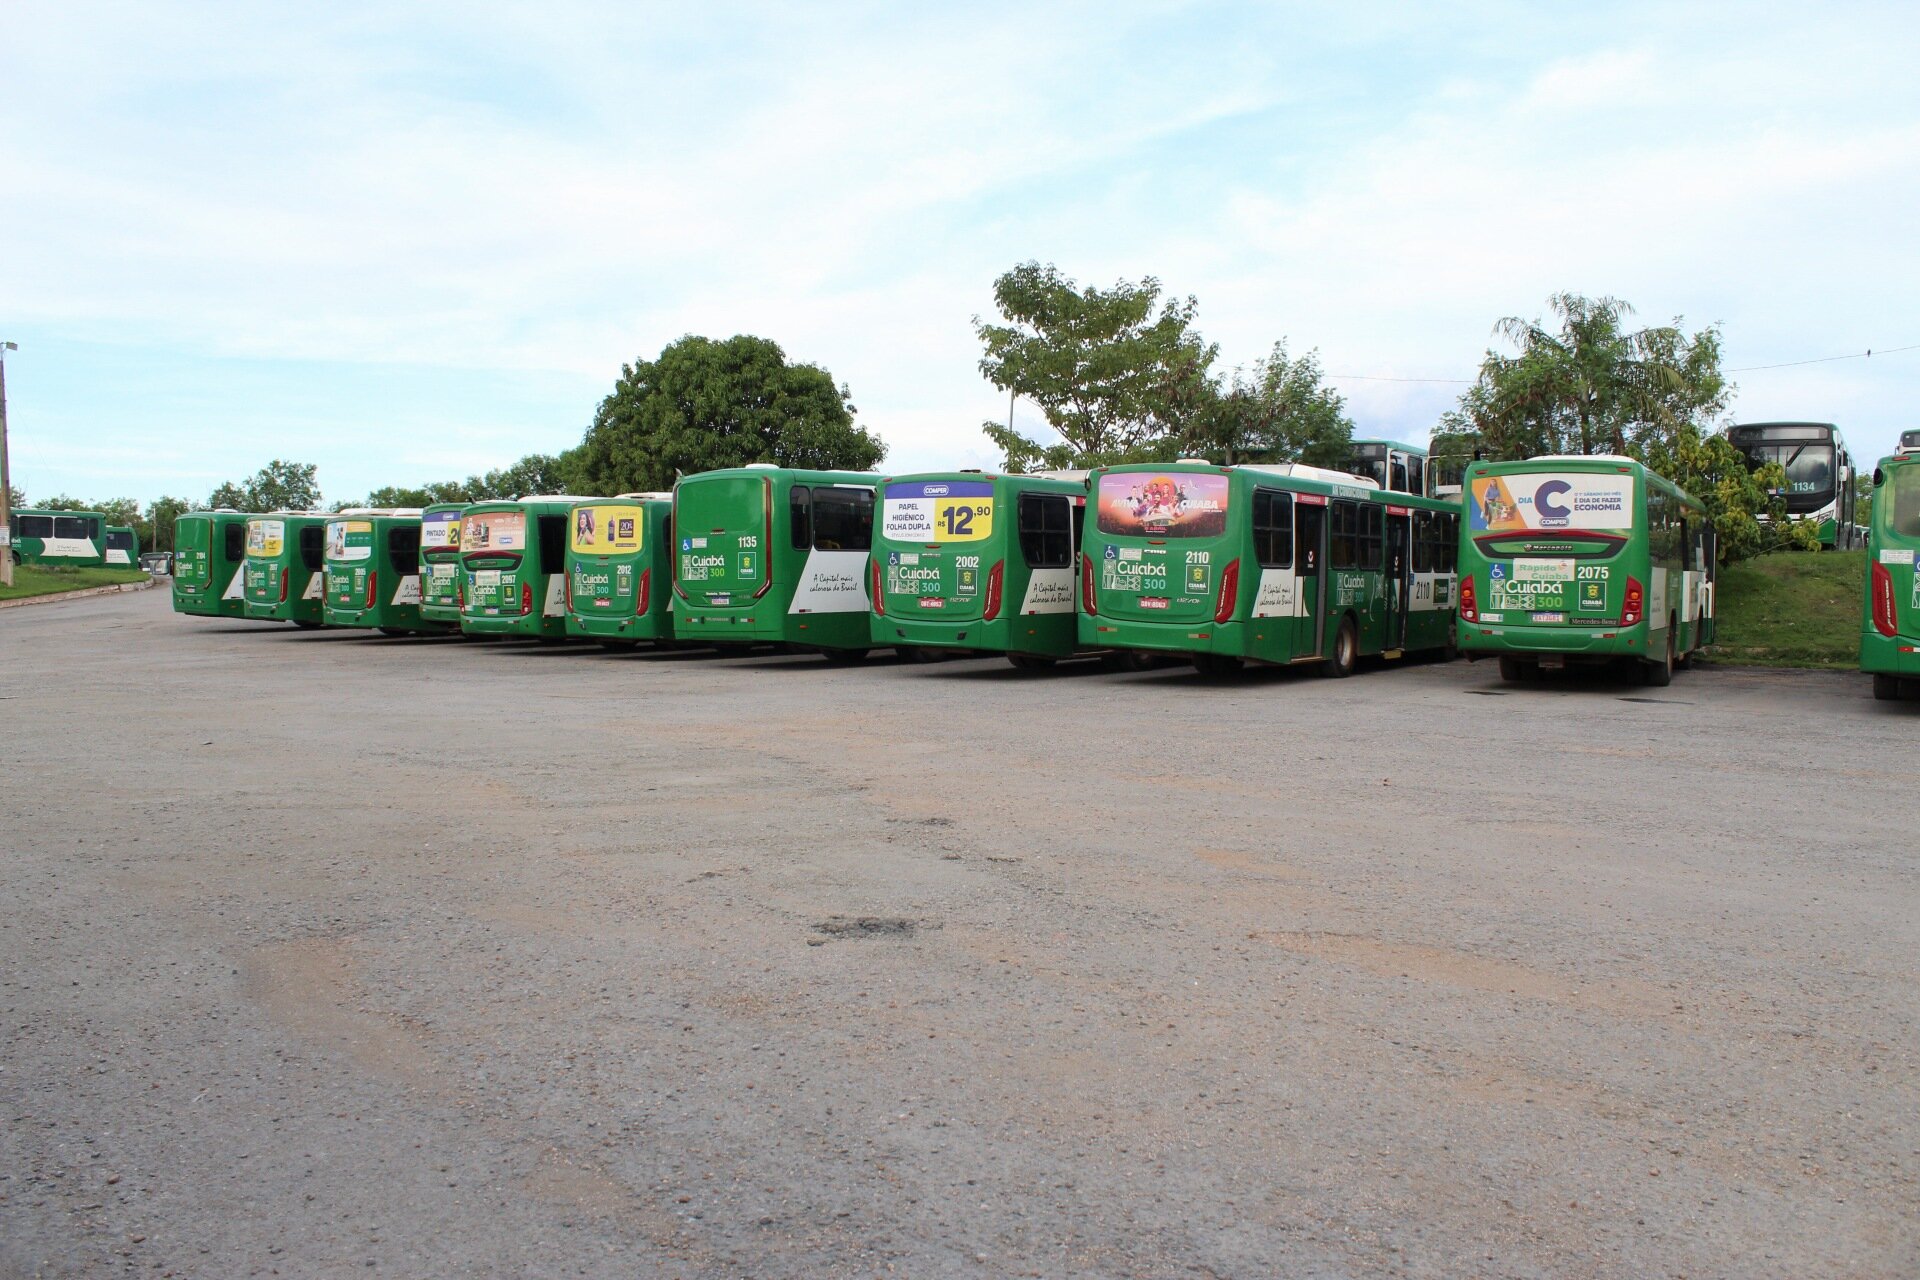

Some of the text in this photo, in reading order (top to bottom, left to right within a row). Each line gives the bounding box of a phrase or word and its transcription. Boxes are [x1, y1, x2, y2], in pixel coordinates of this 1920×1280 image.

[1793, 482, 1815, 491] 1134
[426, 529, 446, 537] PINTADO
[737, 536, 757, 548] 1135
[691, 554, 725, 567] Cuiabá
[955, 556, 979, 568] 2002
[1185, 551, 1209, 564] 2110
[616, 565, 632, 574] 2012
[710, 568, 725, 577] 300
[899, 566, 940, 580] Cuiabá
[1117, 561, 1166, 576] Cuiabá
[1577, 566, 1609, 579] 2075
[581, 574, 609, 584] Cuiabá
[814, 573, 853, 583] A Capital mais
[1143, 579, 1166, 589] 300
[1343, 574, 1364, 588] Cuiabá
[596, 586, 609, 594] 300
[809, 583, 832, 592] calorosa
[840, 582, 858, 592] Brasil
[922, 582, 940, 592] 300
[1038, 582, 1056, 595] Capital
[1416, 581, 1430, 600] 2110
[1506, 580, 1563, 594] Cuiabá
[1537, 596, 1563, 608] 300
